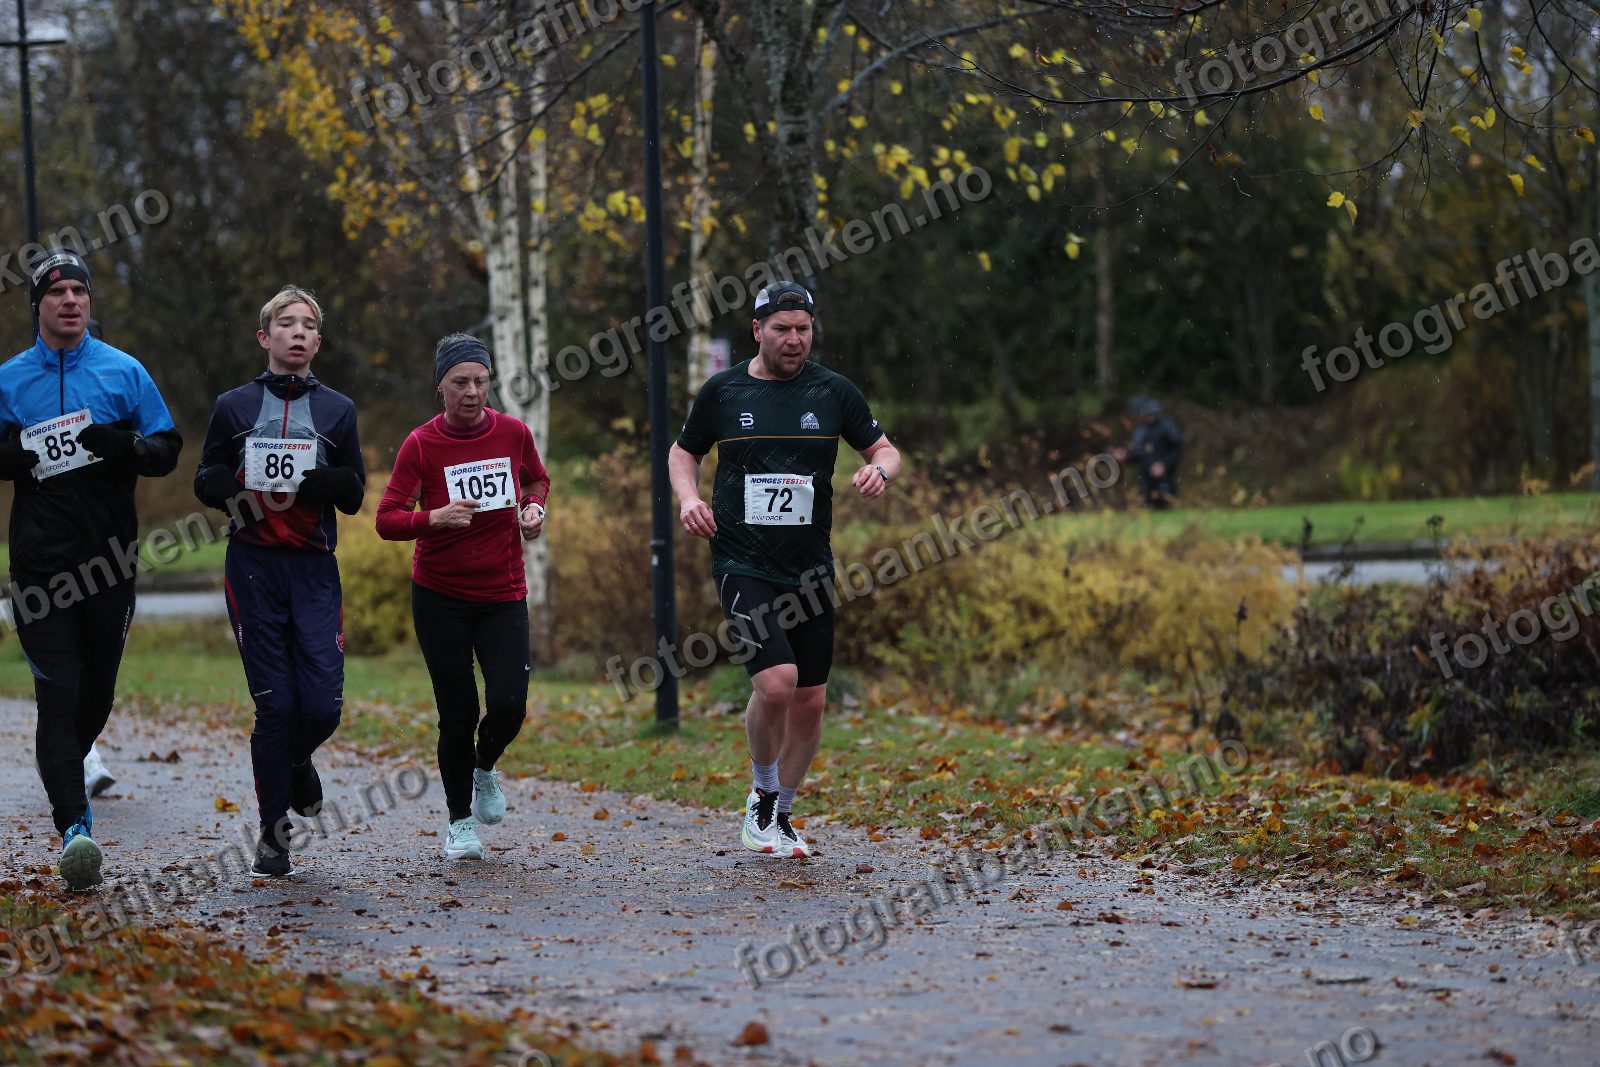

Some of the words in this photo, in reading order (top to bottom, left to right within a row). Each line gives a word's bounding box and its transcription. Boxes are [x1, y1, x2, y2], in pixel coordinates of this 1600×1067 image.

[26, 414, 86, 439] NORGESTESTEN
[44, 430, 77, 461] 85
[251, 442, 313, 451] NORGESTESTEN
[264, 452, 295, 480] 86
[454, 471, 508, 501] 1057
[750, 477, 808, 485] NORGESTESTEN
[764, 487, 793, 513] 72
